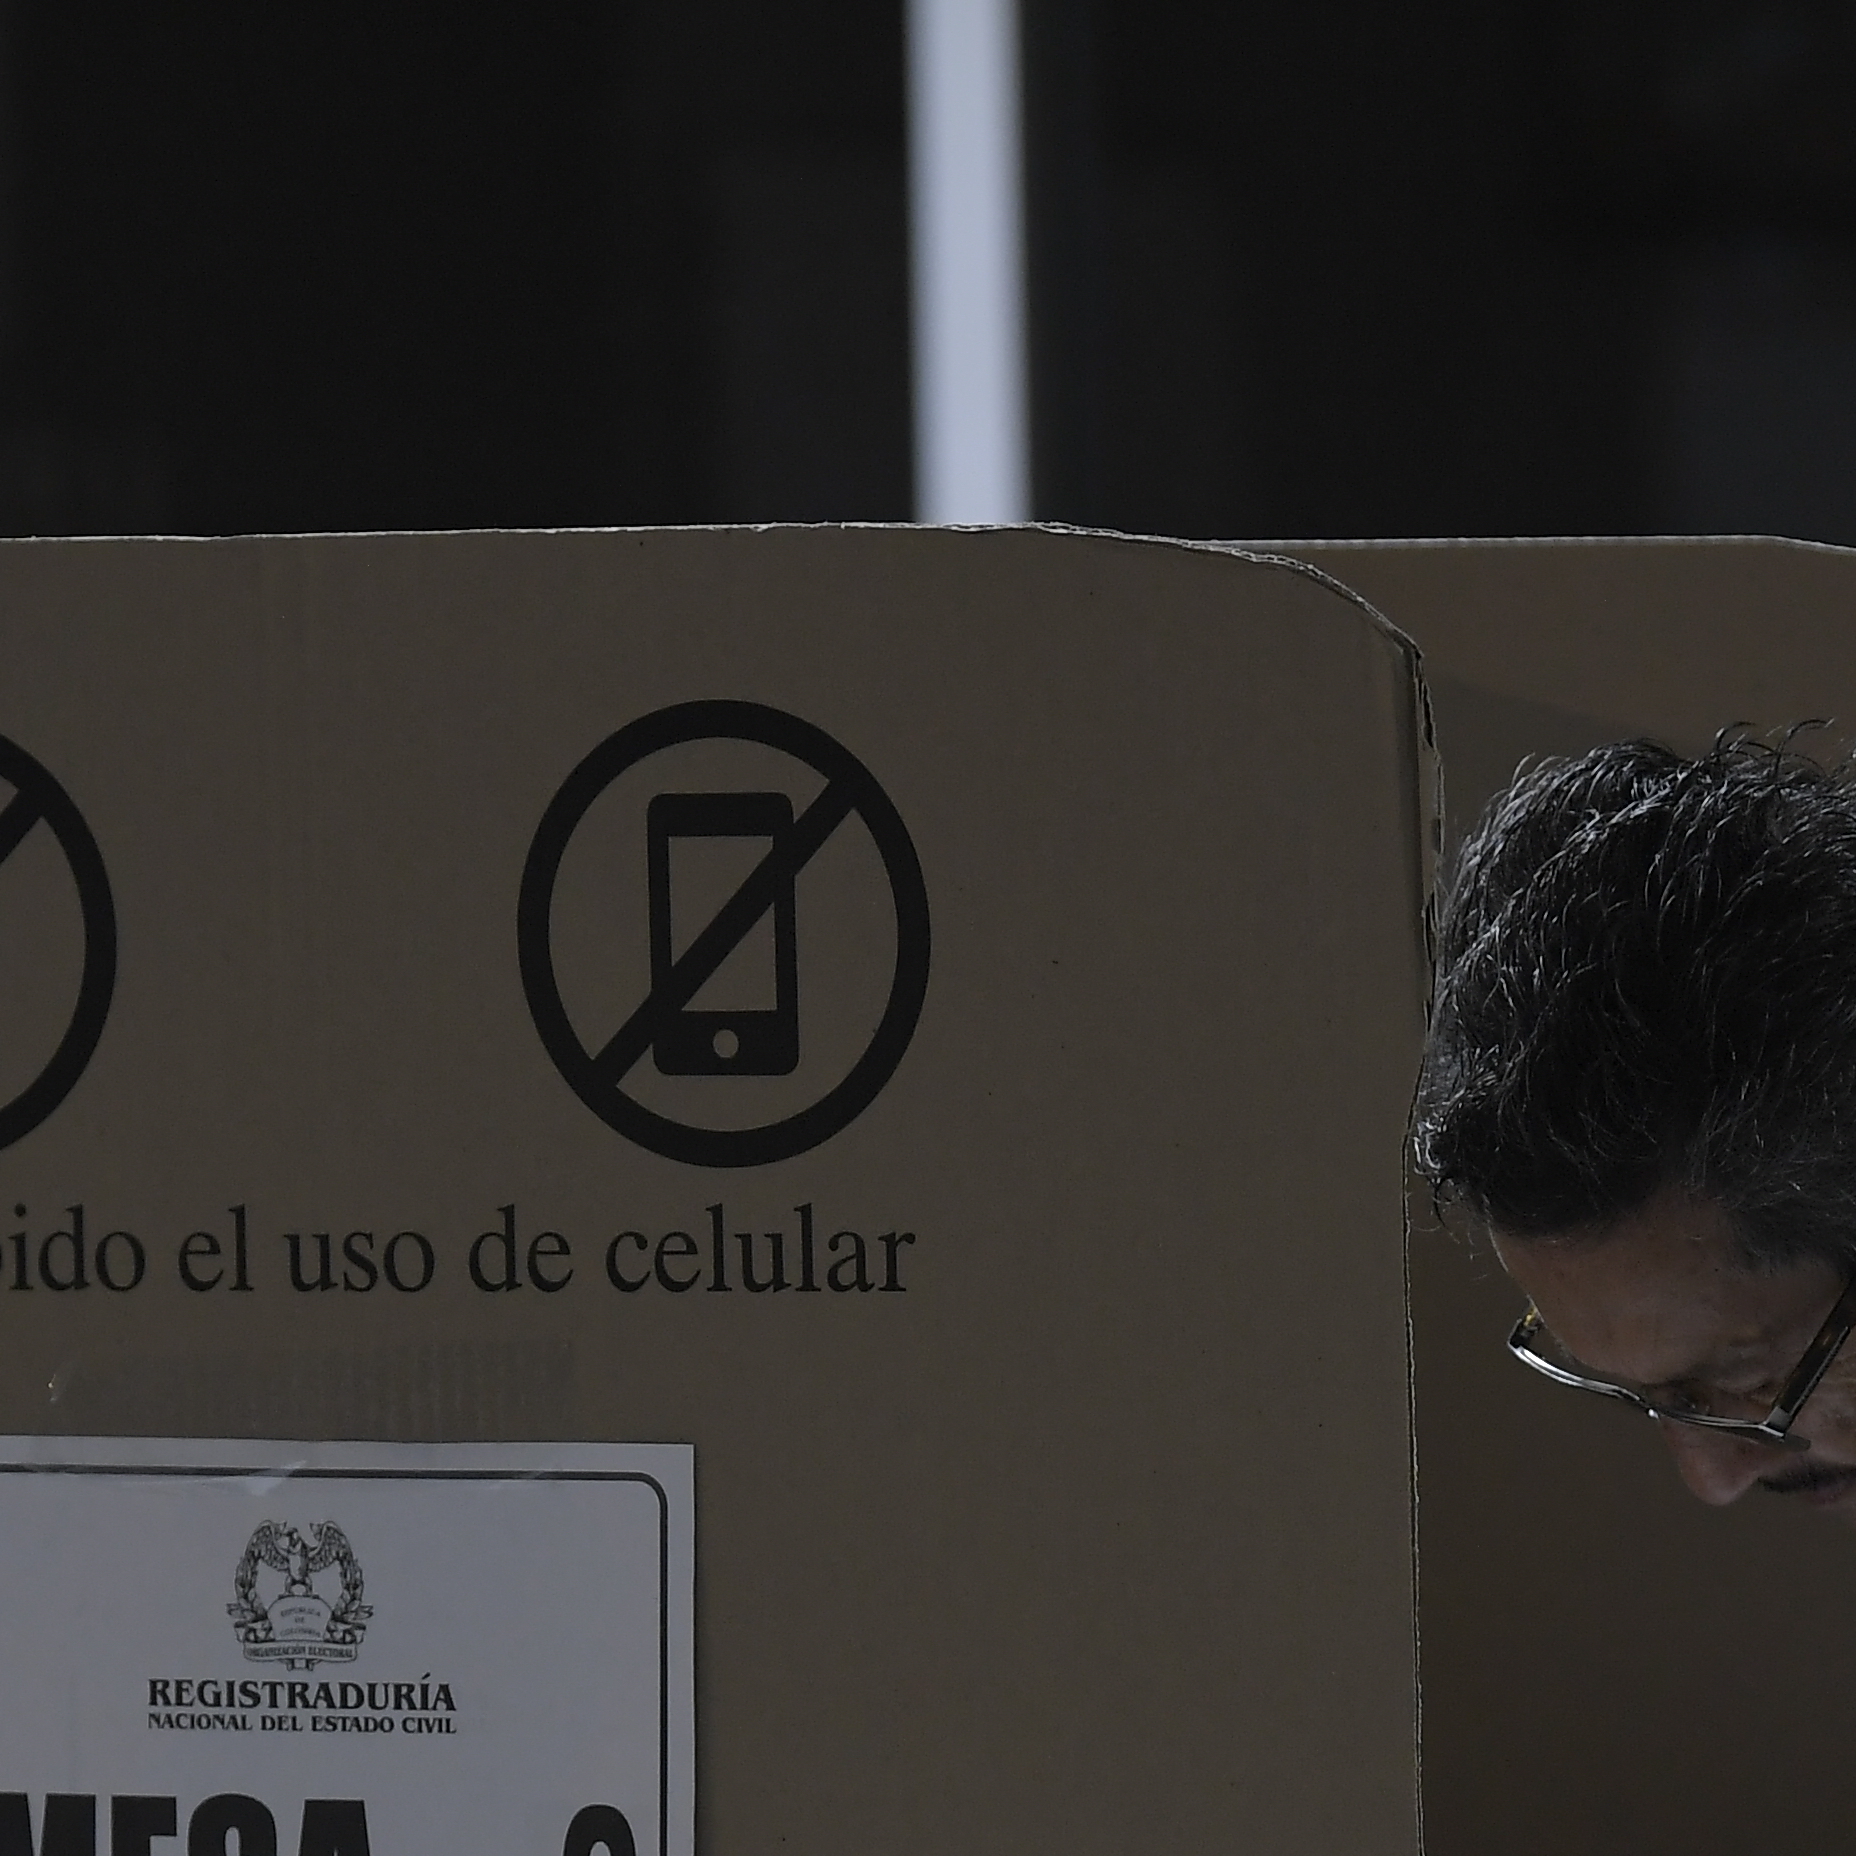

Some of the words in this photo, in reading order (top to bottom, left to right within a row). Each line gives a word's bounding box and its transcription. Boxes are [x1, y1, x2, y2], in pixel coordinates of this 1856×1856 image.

[178, 1202, 255, 1294] el
[282, 1230, 437, 1295] uso
[468, 1202, 575, 1295] de
[605, 1201, 918, 1295] celular
[148, 1672, 457, 1712] REGISTRADURÍA
[148, 1713, 253, 1732] NACIONAL
[261, 1715, 303, 1732] DEL
[311, 1716, 395, 1733] ESTADO
[401, 1717, 457, 1734] CIVIL
